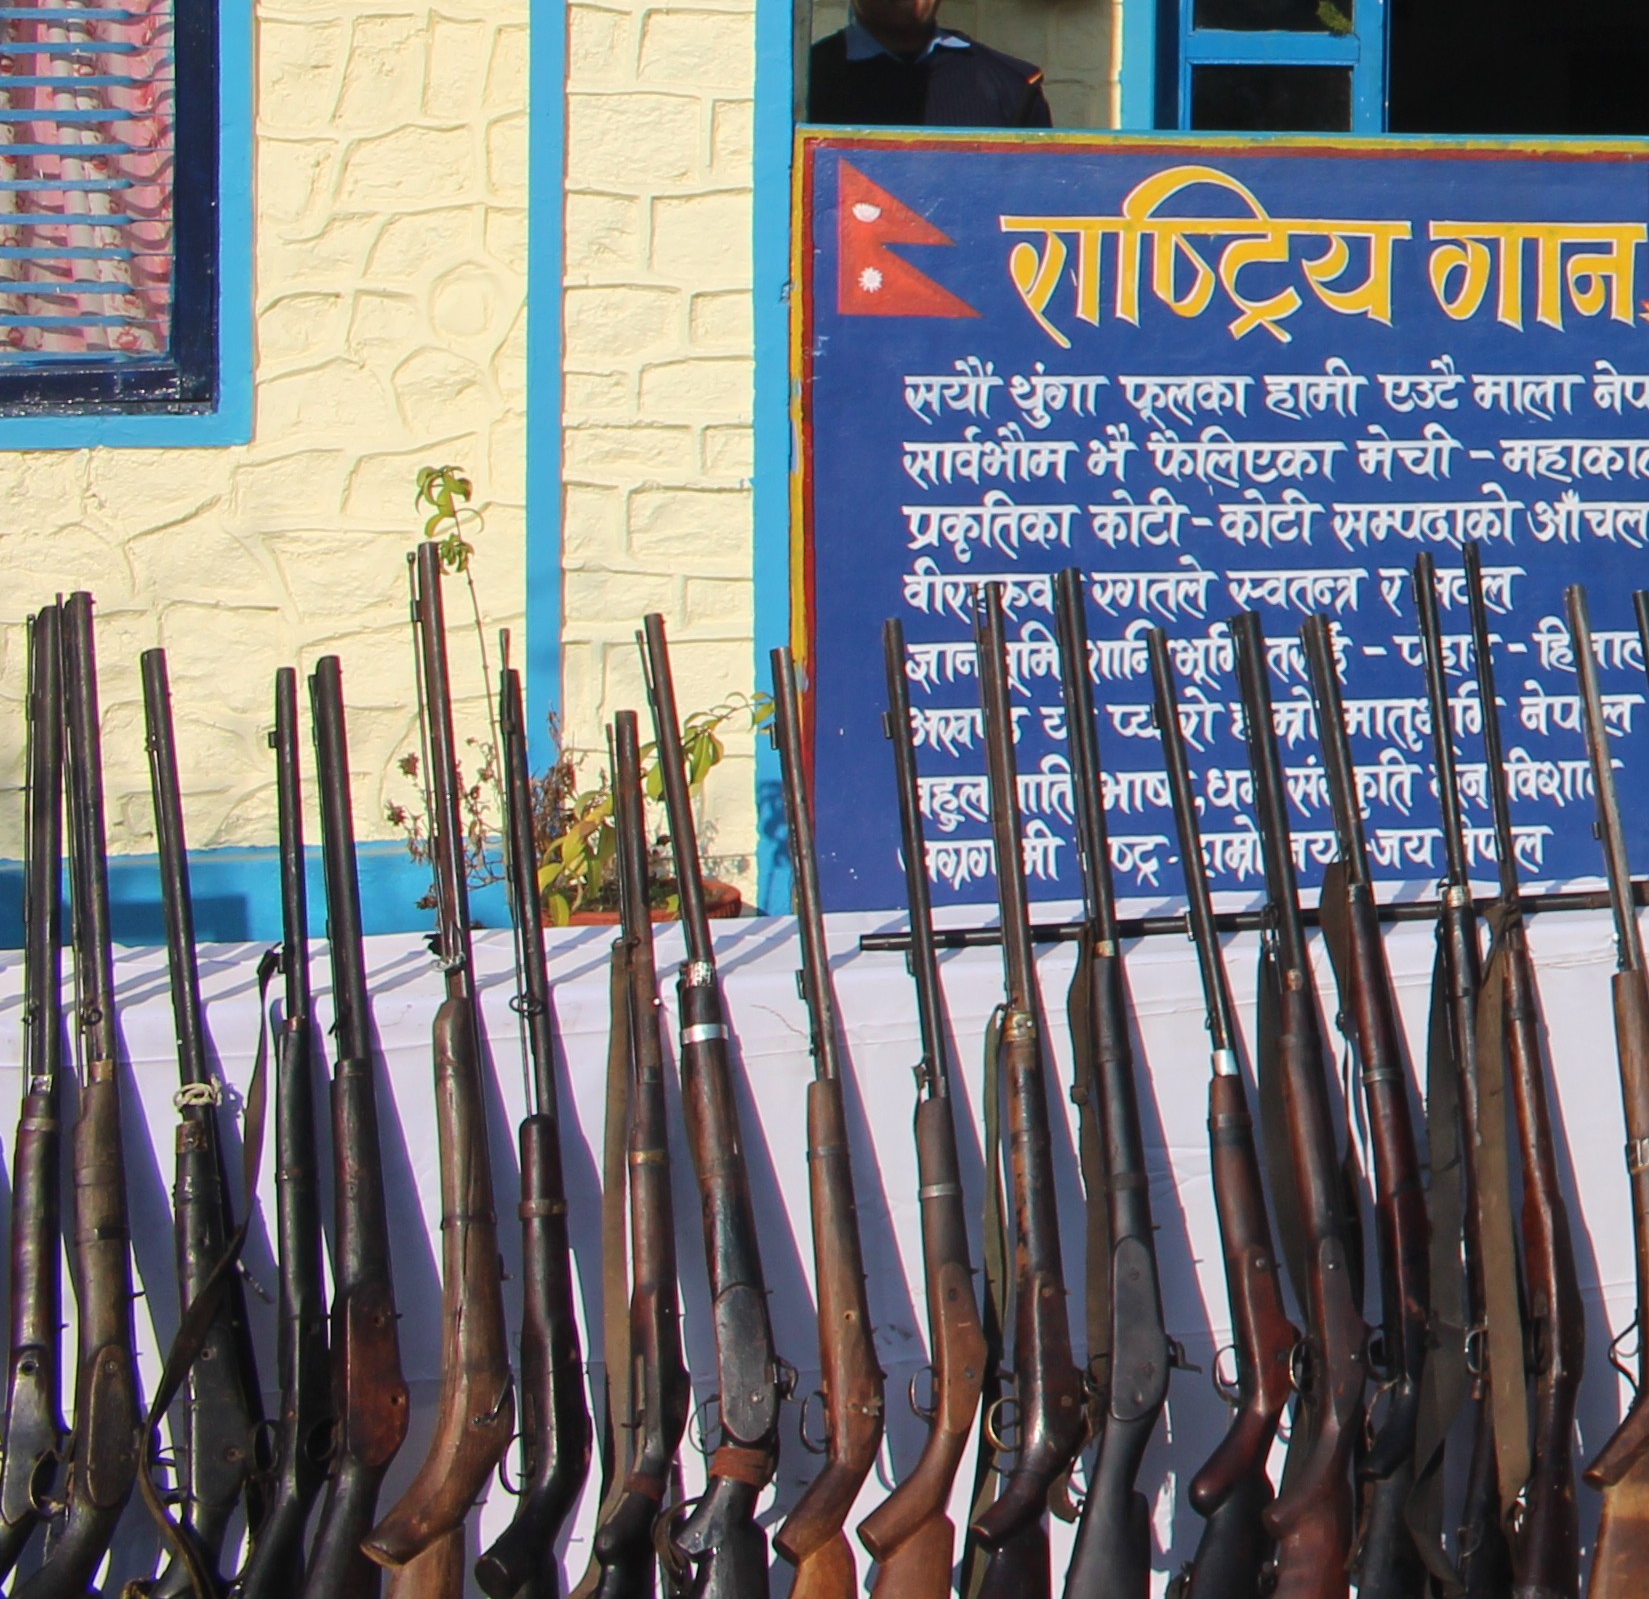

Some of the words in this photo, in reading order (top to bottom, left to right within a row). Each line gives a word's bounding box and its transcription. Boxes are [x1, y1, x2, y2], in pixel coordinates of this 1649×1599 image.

[1000, 165, 1412, 349] राष्ट्रिय
[1429, 220, 1648, 333] गान
[904, 356, 1004, 425] सयौं
[1010, 362, 1110, 429] थुंगा
[1119, 375, 1255, 429] फूलका
[1263, 357, 1369, 421] हामी
[1376, 354, 1465, 413] एउटै
[1472, 374, 1586, 421] माला
[902, 422, 1080, 490] सार्वभौम
[1087, 423, 1139, 482] भै
[1147, 425, 1348, 488] फैलिएका
[902, 489, 1082, 563] प्रकृतिका
[1332, 482, 1526, 553] सम्पदाको
[1090, 554, 1220, 621] रगतले
[1225, 566, 1370, 615] स्वतन्त्र
[1379, 566, 1410, 617] र
[1520, 679, 1646, 738] नेपल
